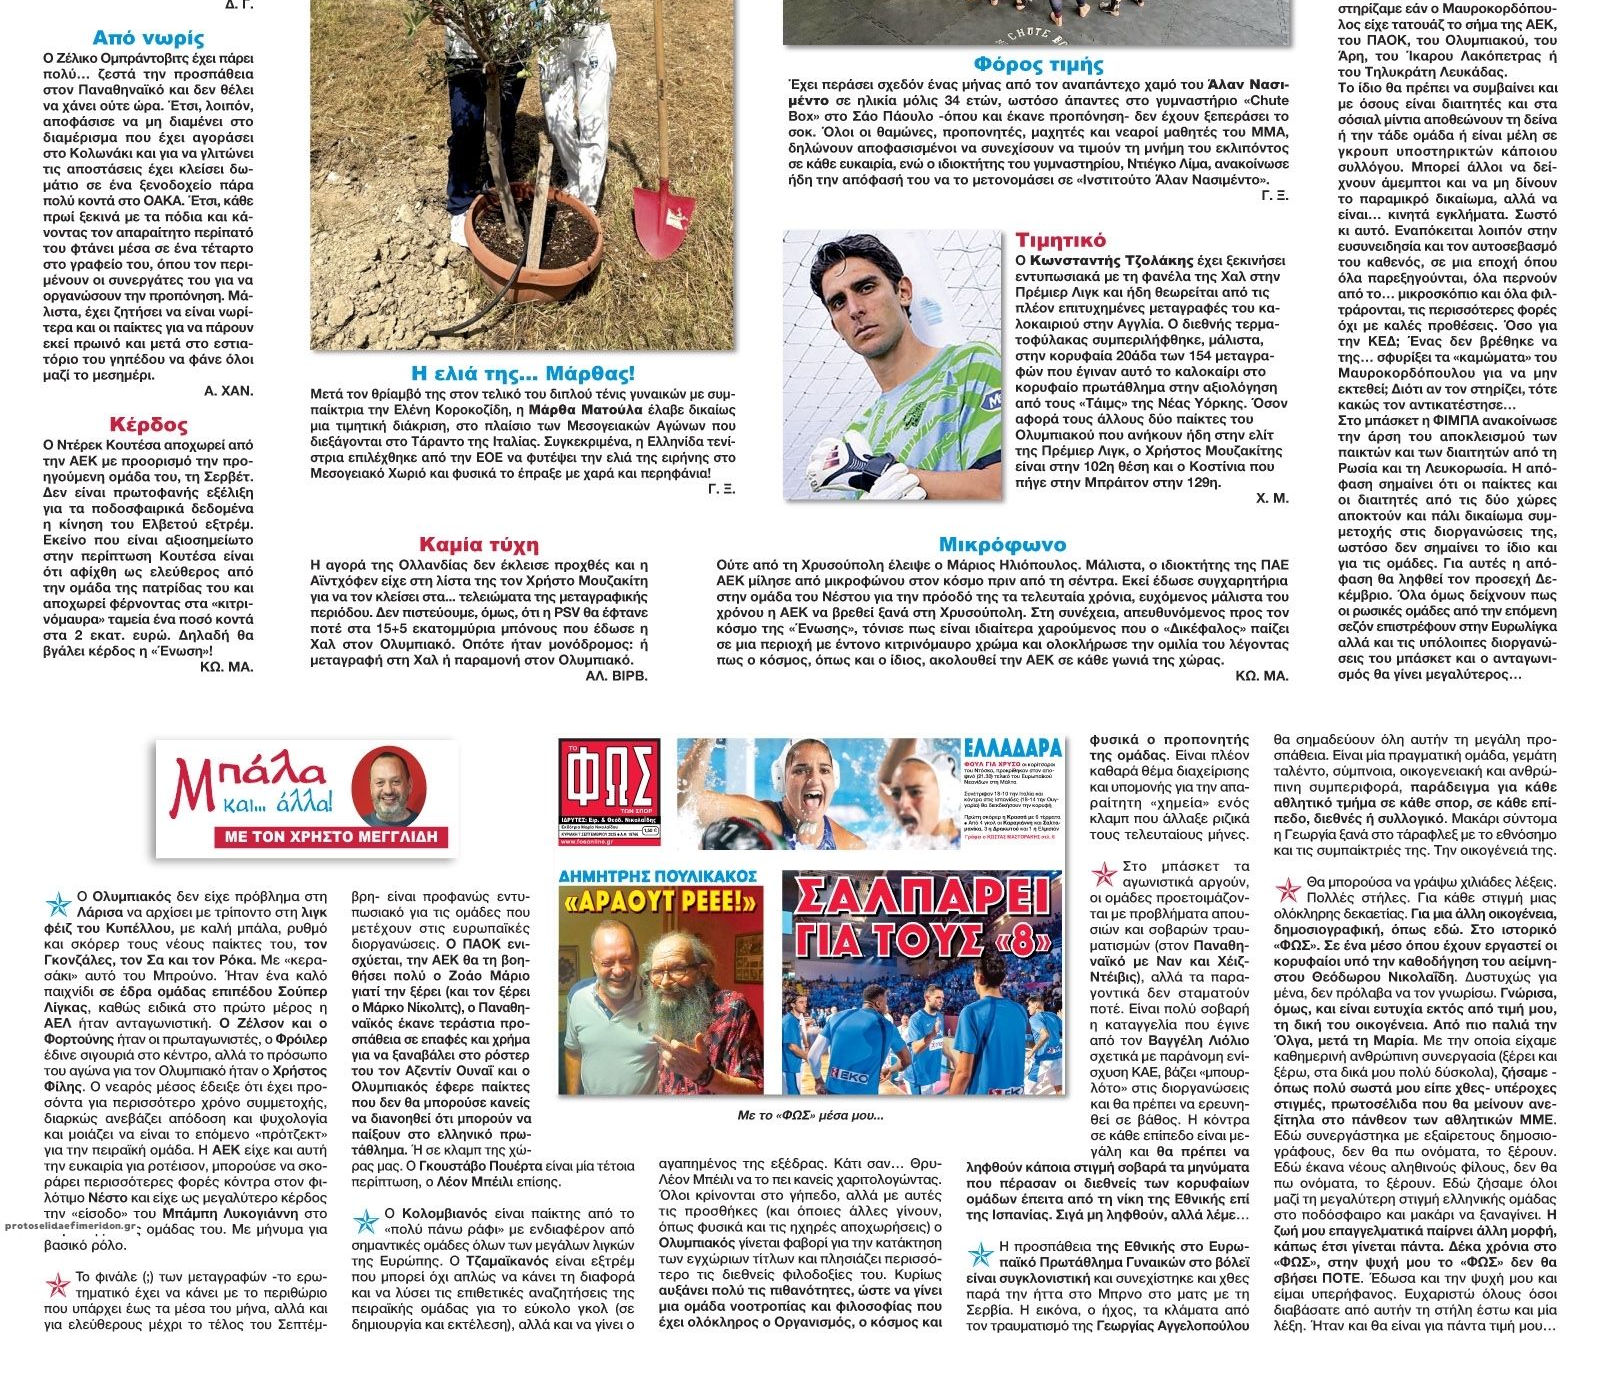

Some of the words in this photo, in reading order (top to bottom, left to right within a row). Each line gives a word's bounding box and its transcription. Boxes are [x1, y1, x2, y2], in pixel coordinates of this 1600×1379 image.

[92, 29, 136, 46] Από
[141, 29, 205, 50] νωρίς
[973, 55, 1044, 76] Φόρος
[1049, 55, 1104, 76] τιμής
[1015, 231, 1107, 252] Τιμητικό
[411, 365, 428, 381] Η
[434, 365, 478, 382] ελιά
[545, 365, 635, 386] Μάρθας!
[110, 416, 188, 437] Κέρδος
[1015, 476, 1047, 491] πήγε
[1050, 479, 1081, 491] στην
[1084, 476, 1150, 491] Μπράιτον
[1152, 479, 1184, 491] στην
[1187, 476, 1222, 491] 129η.
[419, 536, 483, 556] Καμία
[489, 536, 539, 556] τύχη
[939, 536, 1067, 556] Μικρόφωνο
[43, 644, 85, 659] βγάλει
[88, 644, 136, 659] κέρδος
[139, 647, 148, 659] η
[151, 645, 213, 659] «Ένωση»!
[310, 653, 383, 668] μεταγραφή
[386, 656, 410, 668] στη
[413, 654, 439, 666] Χαλ
[442, 653, 451, 668] ή
[454, 653, 521, 668] παραμονή
[524, 656, 555, 666] στον
[558, 653, 634, 668] Ολυμπιακό.
[1235, 669, 1260, 682] ΚΩ.
[1263, 670, 1289, 682] ΜΑ.
[1337, 668, 1371, 682] σμός
[1373, 668, 1391, 680] θα
[1393, 668, 1423, 682] γίνει
[964, 737, 1063, 758] ΕΛΛΑΔΑΡΑ
[1089, 733, 1140, 748] φυσικά
[1146, 736, 1156, 745] ο
[1163, 733, 1250, 748] προπονητής
[169, 748, 327, 820] Μπάλα
[567, 746, 652, 806] ΦΩΣ
[276, 788, 333, 813] άλλα!
[225, 830, 248, 843] ΜΕ
[252, 830, 285, 843] ΤΟΝ
[290, 830, 354, 843] ΧΡΗΣΤΟ
[358, 830, 438, 843] ΜΕΓΓΛΙΔΗ
[561, 838, 614, 846] www.fosonline.gr
[558, 869, 651, 883] ΔΗΜΗΤΡΗΣ
[654, 868, 758, 884] ΠΟΥΛΙΚΑΚΟΣ
[76, 890, 88, 902] Ο
[92, 890, 172, 905] Ολυμπιακός
[176, 890, 200, 902] δεν
[204, 890, 230, 905] είχε
[234, 890, 301, 905] πρόβλημα
[304, 893, 328, 905] στη
[564, 890, 676, 914] «ΑΡΑΟΥΤ
[683, 890, 758, 914] ΡΕΕΕ!»
[795, 876, 1051, 916] ΣΑΛΠΑΡΕΙ
[795, 923, 865, 958] ΓΙΑ
[872, 923, 984, 959] ΤΟΥΣ
[995, 923, 1053, 959] «8»
[841, 1071, 869, 1084] EKO
[737, 1109, 756, 1121] Με
[758, 1112, 774, 1121] το
[775, 1109, 816, 1121] «ΦΩΣ»
[818, 1109, 849, 1123] μέσα
[44, 1239, 88, 1253] βασικό
[91, 1239, 127, 1253] ρόλο.
[1273, 1319, 1307, 1334] λέξη.
[1310, 1319, 1345, 1332] Ήταν
[1348, 1322, 1368, 1332] και
[1370, 1319, 1388, 1332] θα
[1391, 1319, 1421, 1332] είναι
[1424, 1322, 1444, 1334] για
[1446, 1319, 1487, 1332] πάντα
[1489, 1319, 1515, 1334] τιμή
